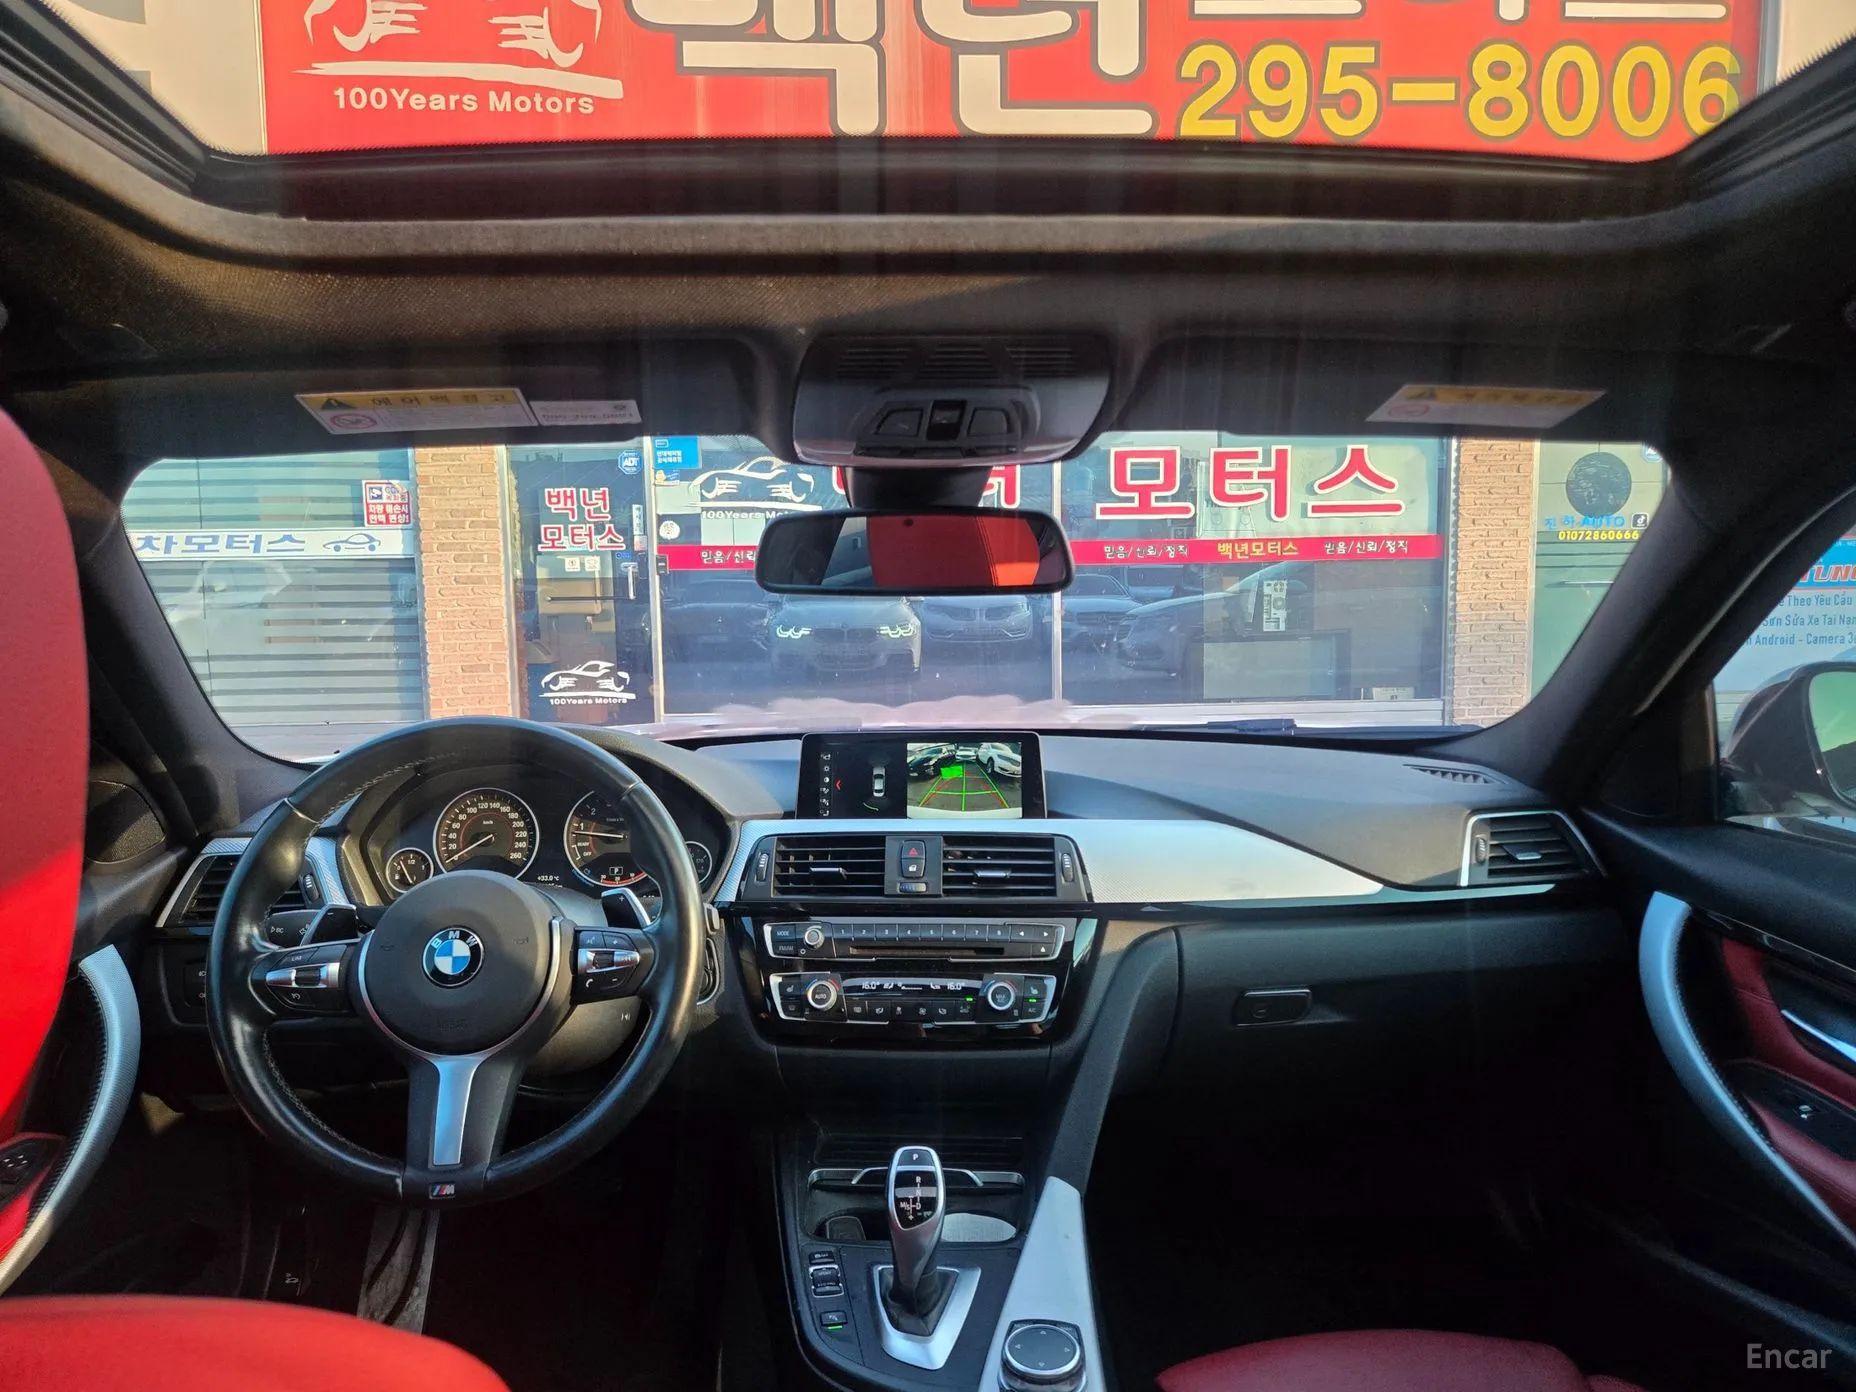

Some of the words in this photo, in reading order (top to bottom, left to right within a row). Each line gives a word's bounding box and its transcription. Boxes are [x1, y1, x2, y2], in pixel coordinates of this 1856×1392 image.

[1179, 43, 1741, 139] 295-8006
[334, 87, 478, 112] 100Years
[488, 91, 595, 114] Motors
[623, 457, 639, 467] ADT
[1096, 445, 1405, 521] 모터스
[545, 488, 611, 521] 백년
[701, 511, 761, 519] 100Years
[136, 533, 306, 555] 차모터스
[538, 524, 626, 551] 모터스
[1559, 531, 1640, 541] 01072860666
[1217, 541, 1299, 559] 백년모터스
[1787, 595, 1812, 606] Theo
[1807, 614, 1820, 626] Xe
[1755, 633, 1795, 645] Android
[1806, 633, 1845, 645] Camera
[431, 930, 478, 949] BMW
